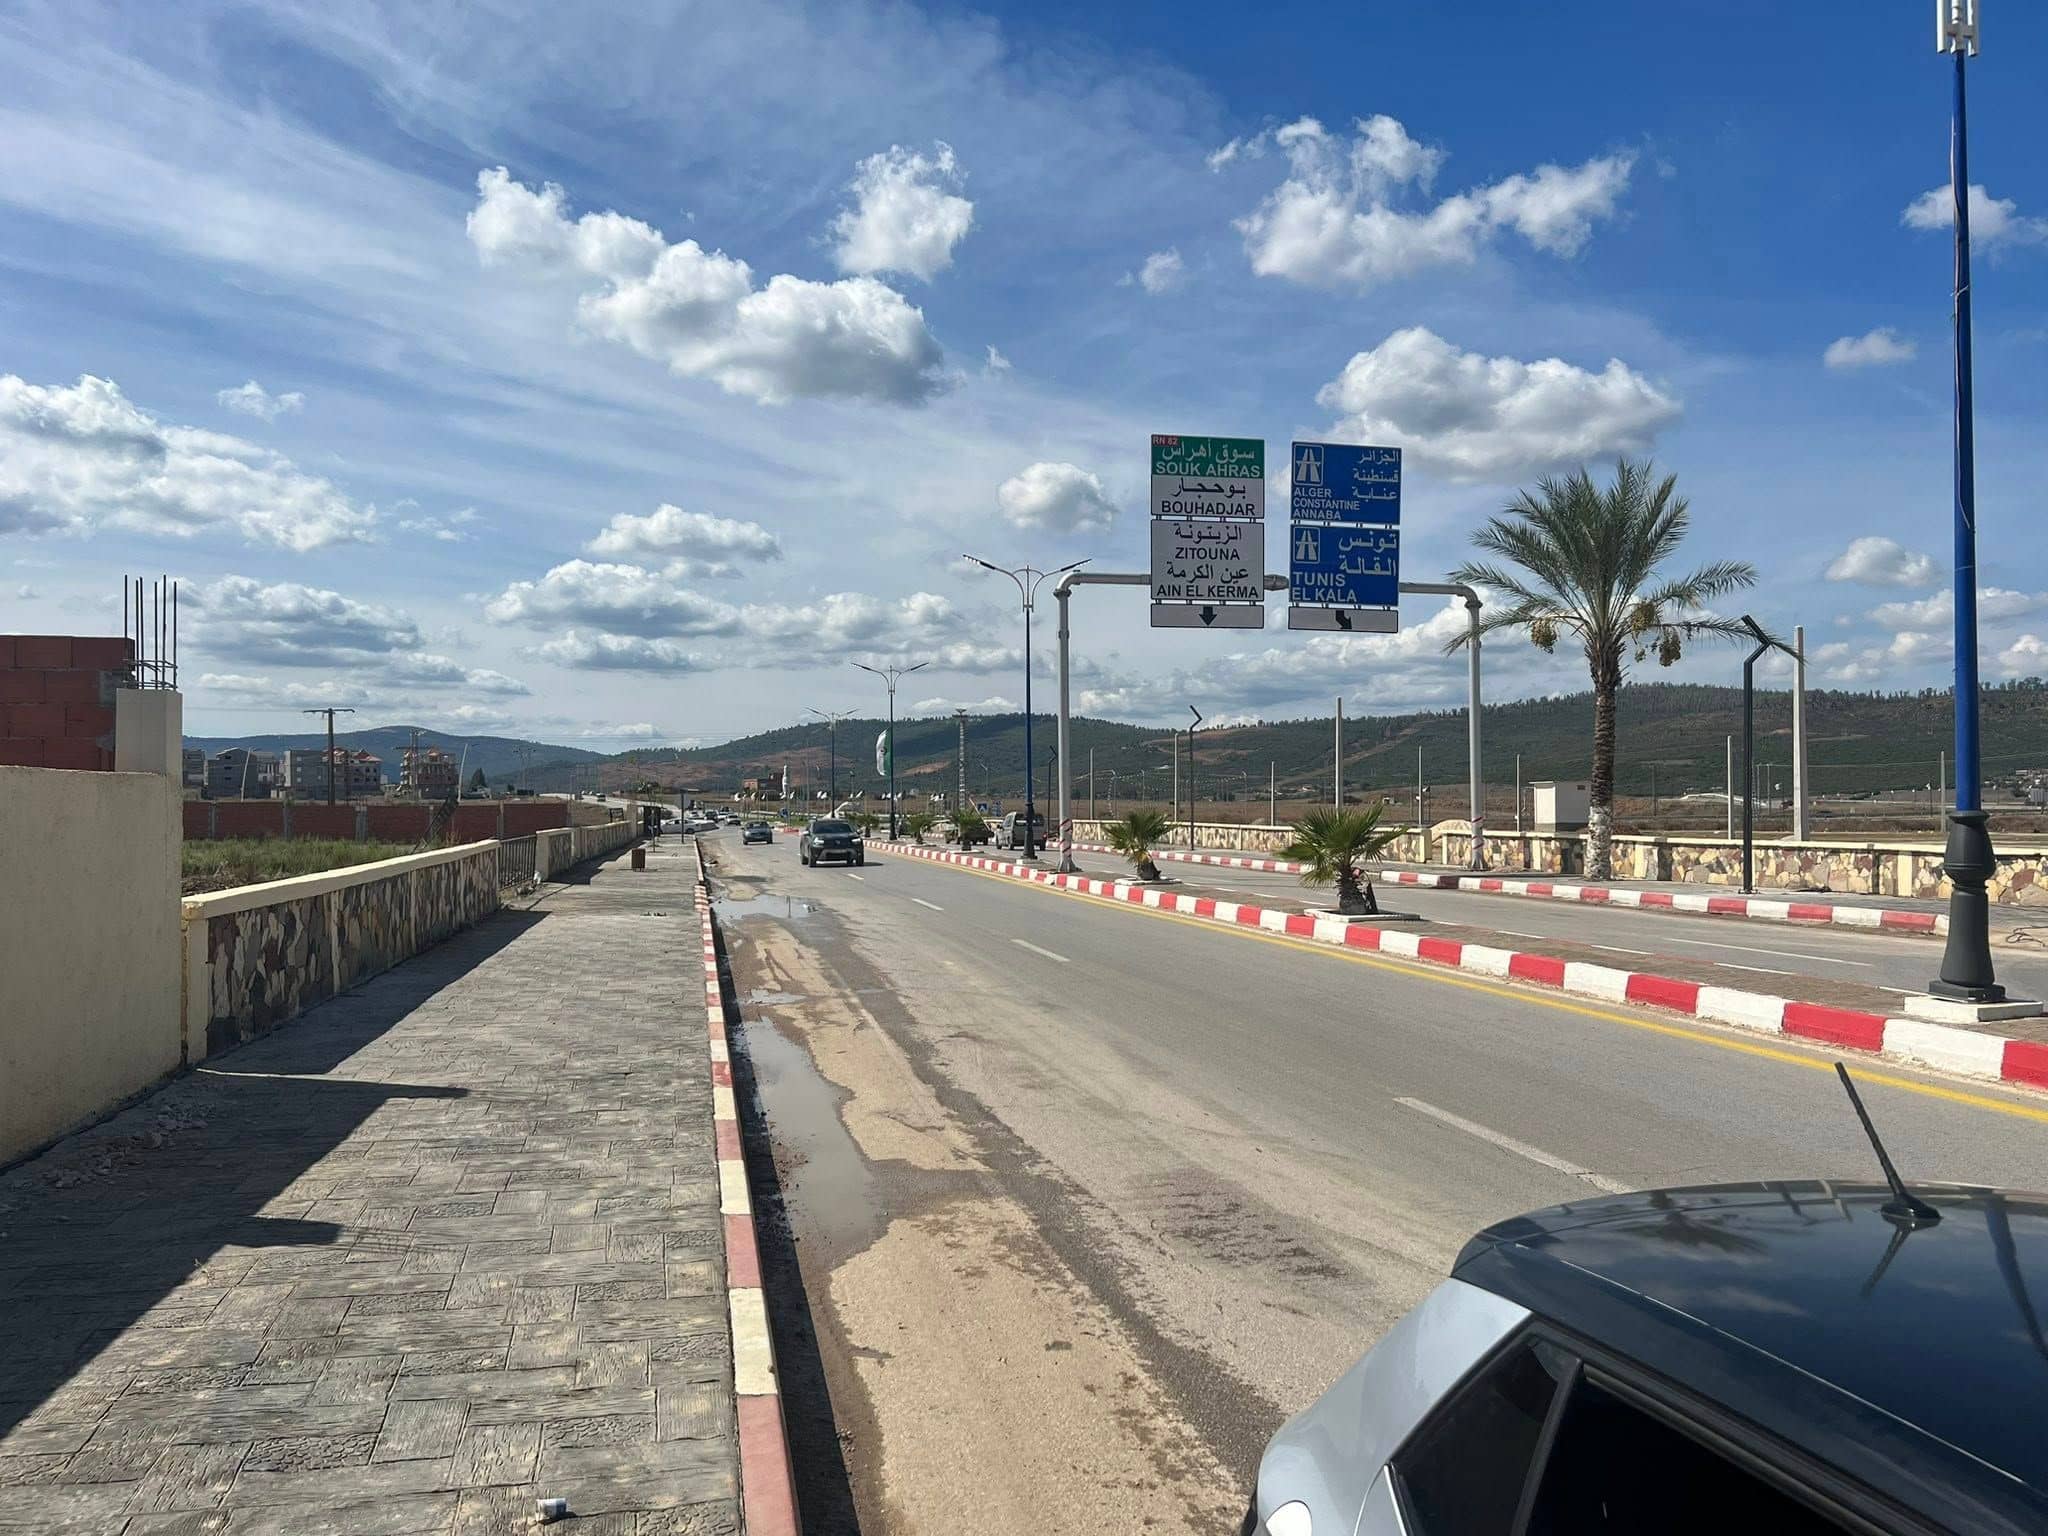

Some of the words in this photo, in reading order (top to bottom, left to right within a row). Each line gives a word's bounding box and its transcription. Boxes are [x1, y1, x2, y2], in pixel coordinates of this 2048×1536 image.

[1215, 444, 1255, 464] سوق
[1156, 462, 1201, 475] SOUK
[1206, 463, 1260, 477] AHRAS
[1352, 467, 1399, 484] قسنطينة
[1170, 477, 1246, 499] بوحجار
[1294, 487, 1332, 498] ALGER
[1352, 486, 1397, 502] عنابة
[1161, 500, 1256, 516] BOUHADJAR
[1293, 497, 1360, 511] CONSTANTINE
[1293, 508, 1342, 520] ANNABA
[1173, 523, 1242, 545] الزيتونة
[1338, 531, 1397, 554] تونس
[1174, 547, 1240, 560] ZITOUNA
[1166, 561, 1214, 583] الكرمة
[1338, 554, 1396, 576] القالة
[1220, 567, 1249, 585] عين
[1292, 571, 1346, 587] TUNIS
[1156, 584, 1181, 597] AIN
[1186, 585, 1204, 597] EL
[1207, 585, 1259, 599] KERMA
[1291, 587, 1311, 601] EL
[1315, 588, 1357, 603] KALA
